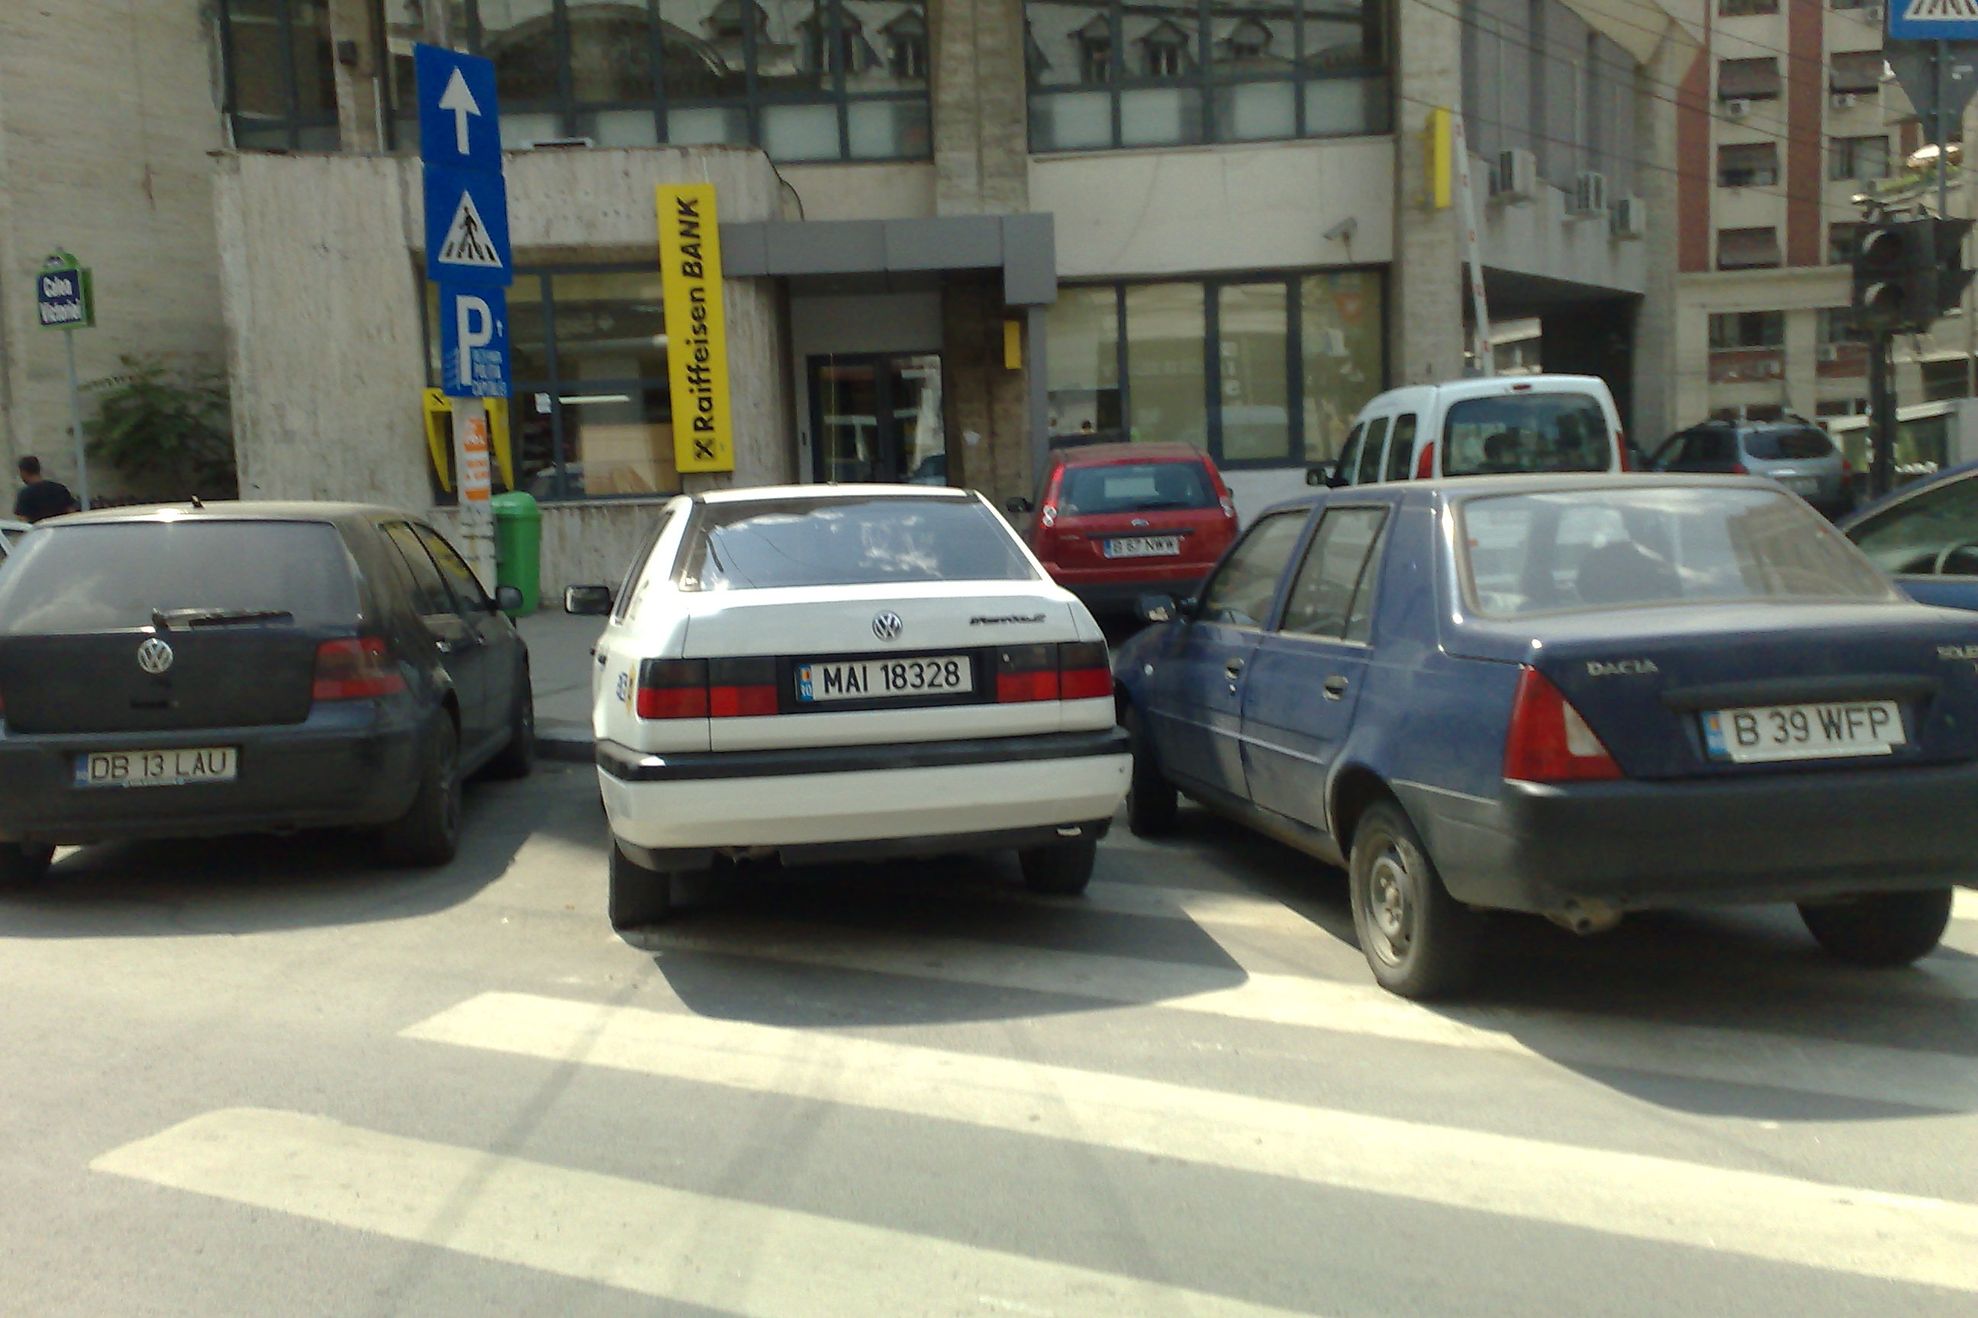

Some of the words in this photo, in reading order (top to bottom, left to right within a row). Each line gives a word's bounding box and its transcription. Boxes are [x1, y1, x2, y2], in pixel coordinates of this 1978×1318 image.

[676, 195, 704, 280] BANK
[456, 294, 493, 386] P
[686, 286, 715, 432] Raiffeisen
[823, 664, 869, 695] MAI
[880, 660, 961, 691] 18328
[1586, 660, 1659, 677] DACIA
[1734, 712, 1760, 746] B
[1769, 706, 1810, 744] 39
[1816, 705, 1890, 741] WFP
[91, 756, 130, 780] DB
[142, 753, 165, 777] 13
[175, 751, 227, 776] LAU
